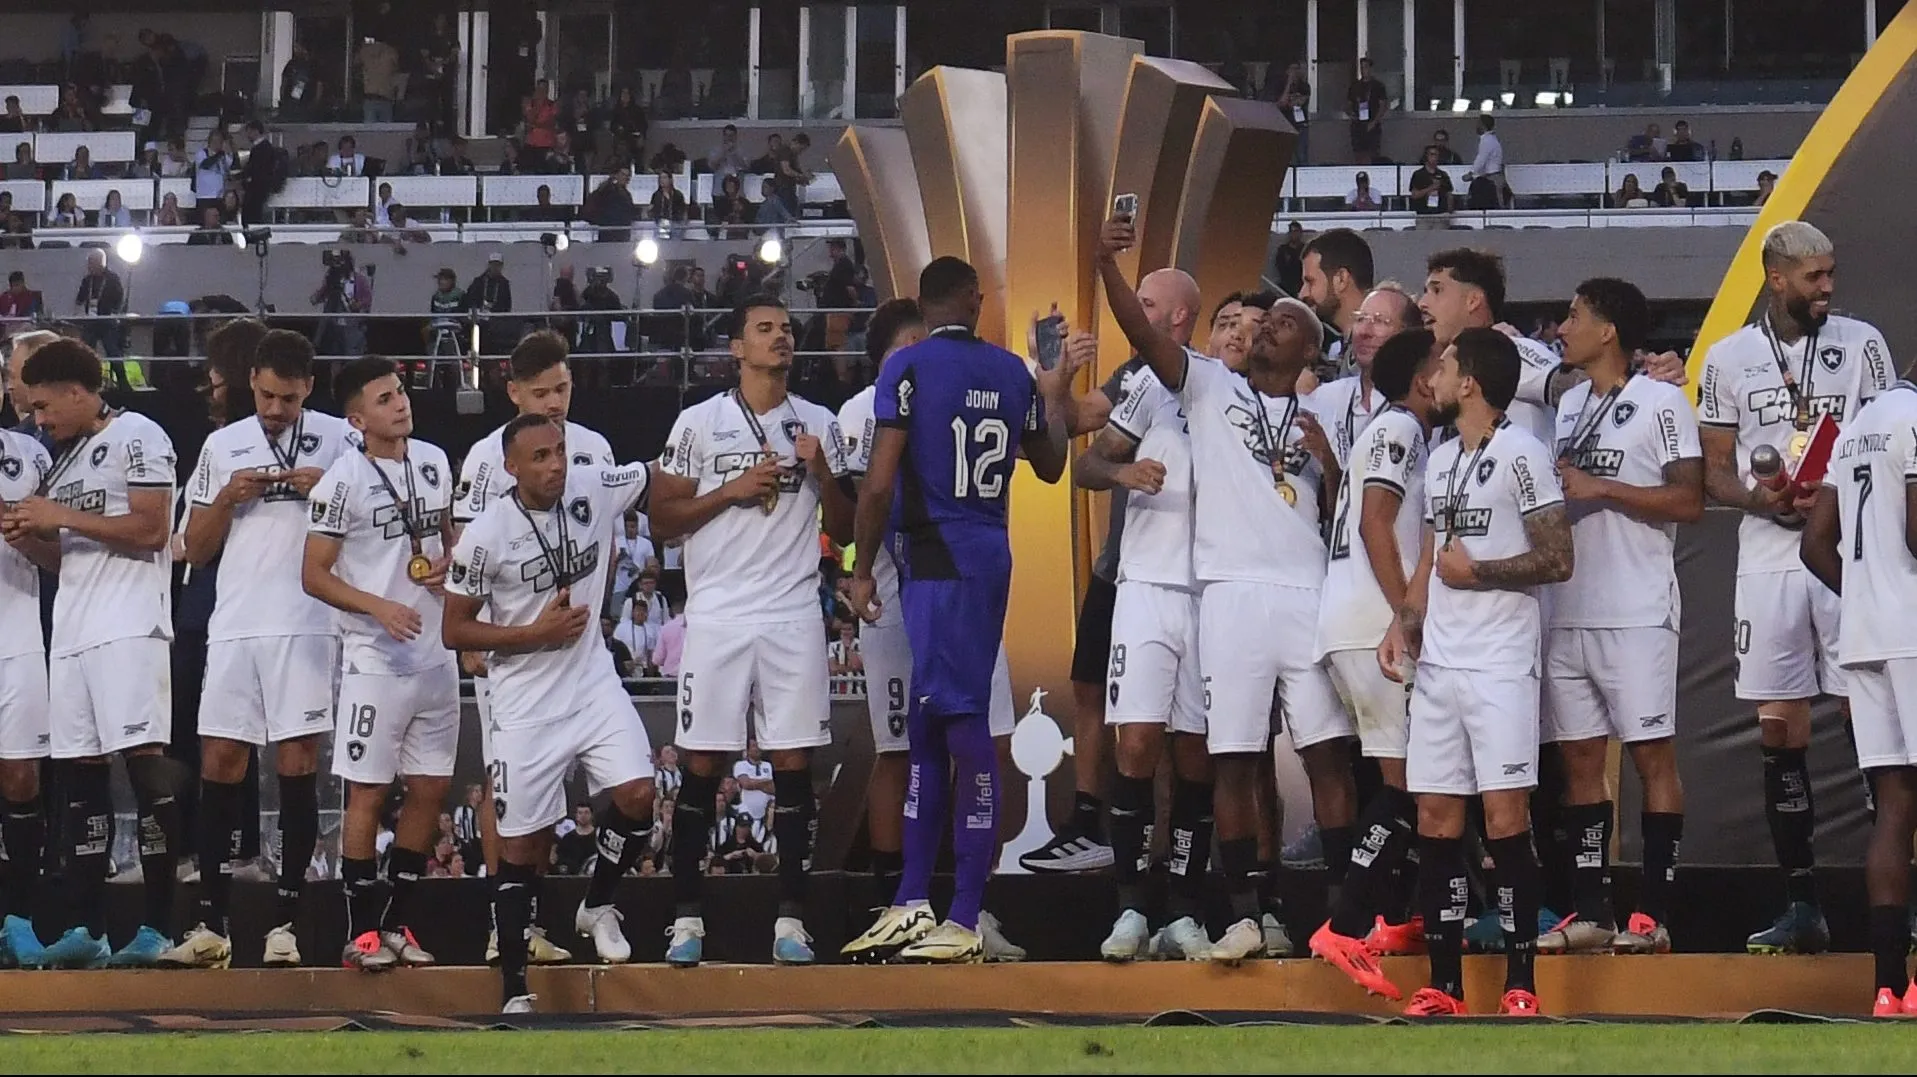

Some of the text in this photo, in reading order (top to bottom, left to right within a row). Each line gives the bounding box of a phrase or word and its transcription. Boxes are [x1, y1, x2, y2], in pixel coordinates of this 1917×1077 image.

[1866, 339, 1887, 391] Centrum
[965, 389, 1000, 409] JOHN
[1120, 374, 1151, 421] Centrum
[1705, 364, 1715, 419] Centrum
[951, 415, 1009, 498] 12
[1515, 455, 1537, 506] Centrum
[469, 461, 489, 512] Centrum
[1853, 463, 1873, 561] 7
[466, 545, 485, 596] Centrum
[682, 672, 694, 706] 5
[888, 677, 905, 711] 9
[349, 702, 377, 738] 18
[976, 772, 993, 817] Lifefit
[883, 910, 934, 942] AIR
